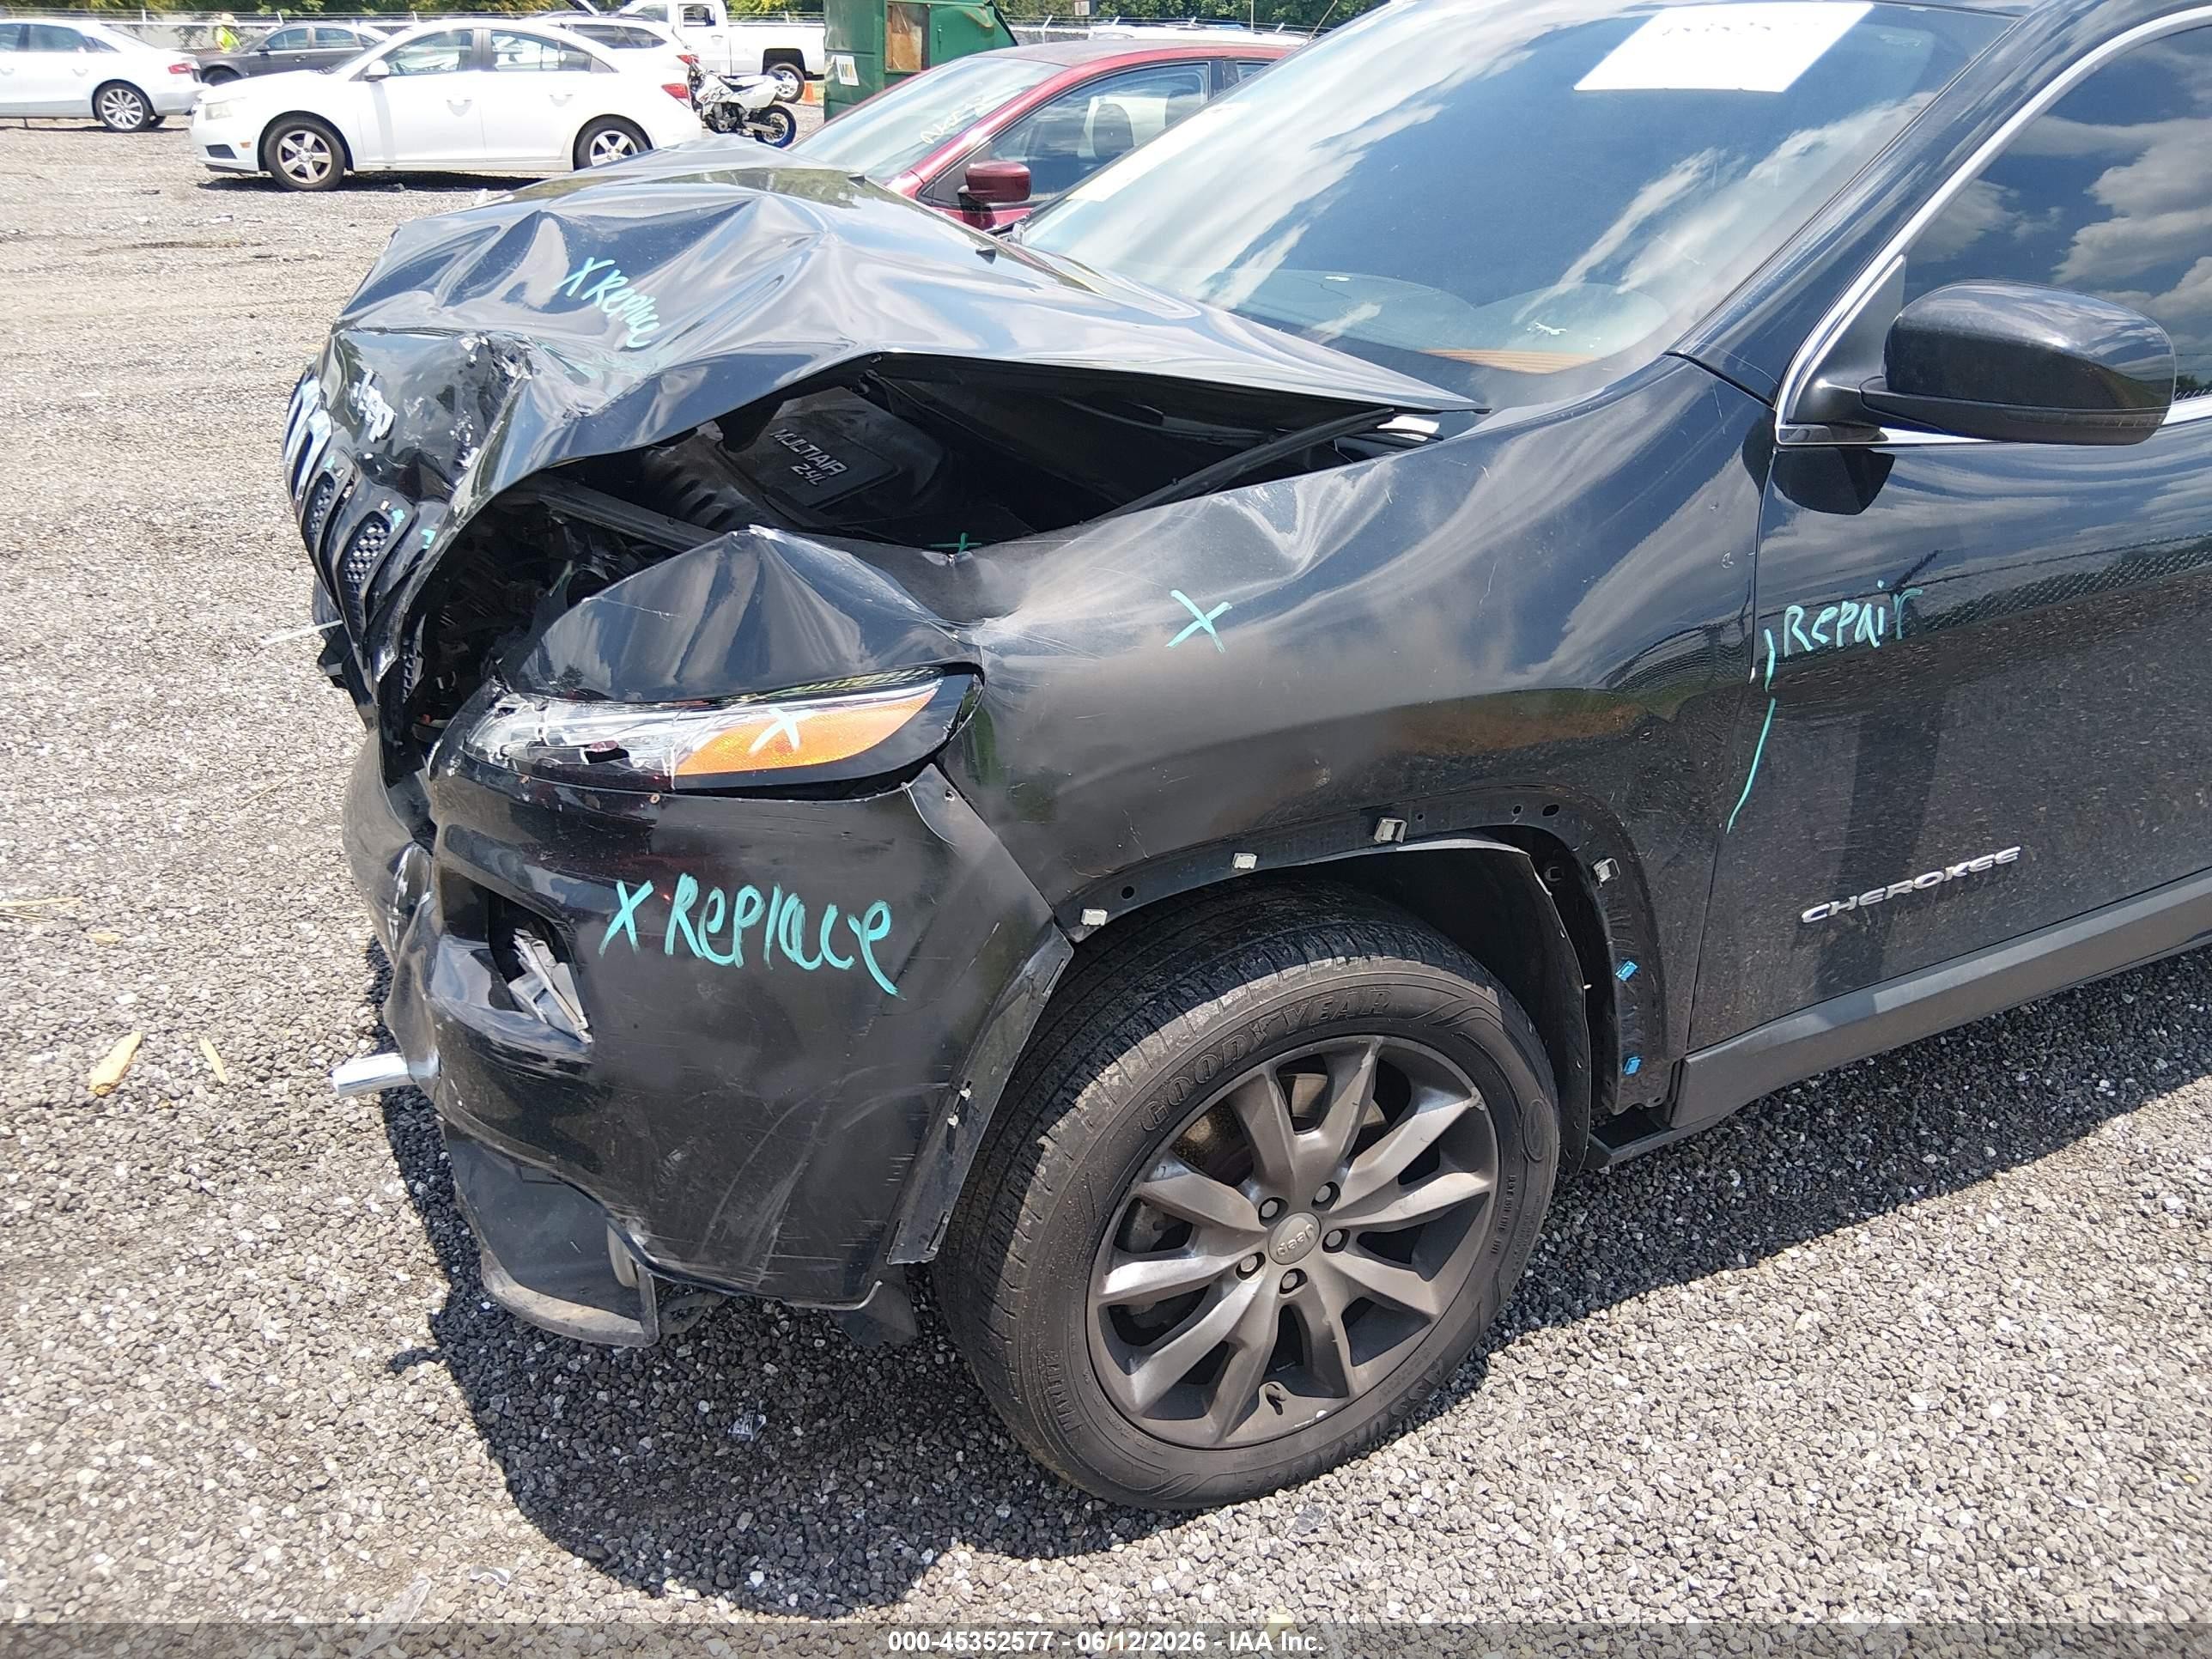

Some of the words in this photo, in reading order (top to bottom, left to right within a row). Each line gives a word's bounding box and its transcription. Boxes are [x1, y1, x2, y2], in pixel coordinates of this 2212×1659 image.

[769, 428, 848, 477] MULTIAIR
[1802, 846, 2021, 923] CHEROKEE
[1139, 988, 1393, 1133] GOODYEAR
[1276, 1223, 1315, 1257] Jeep
